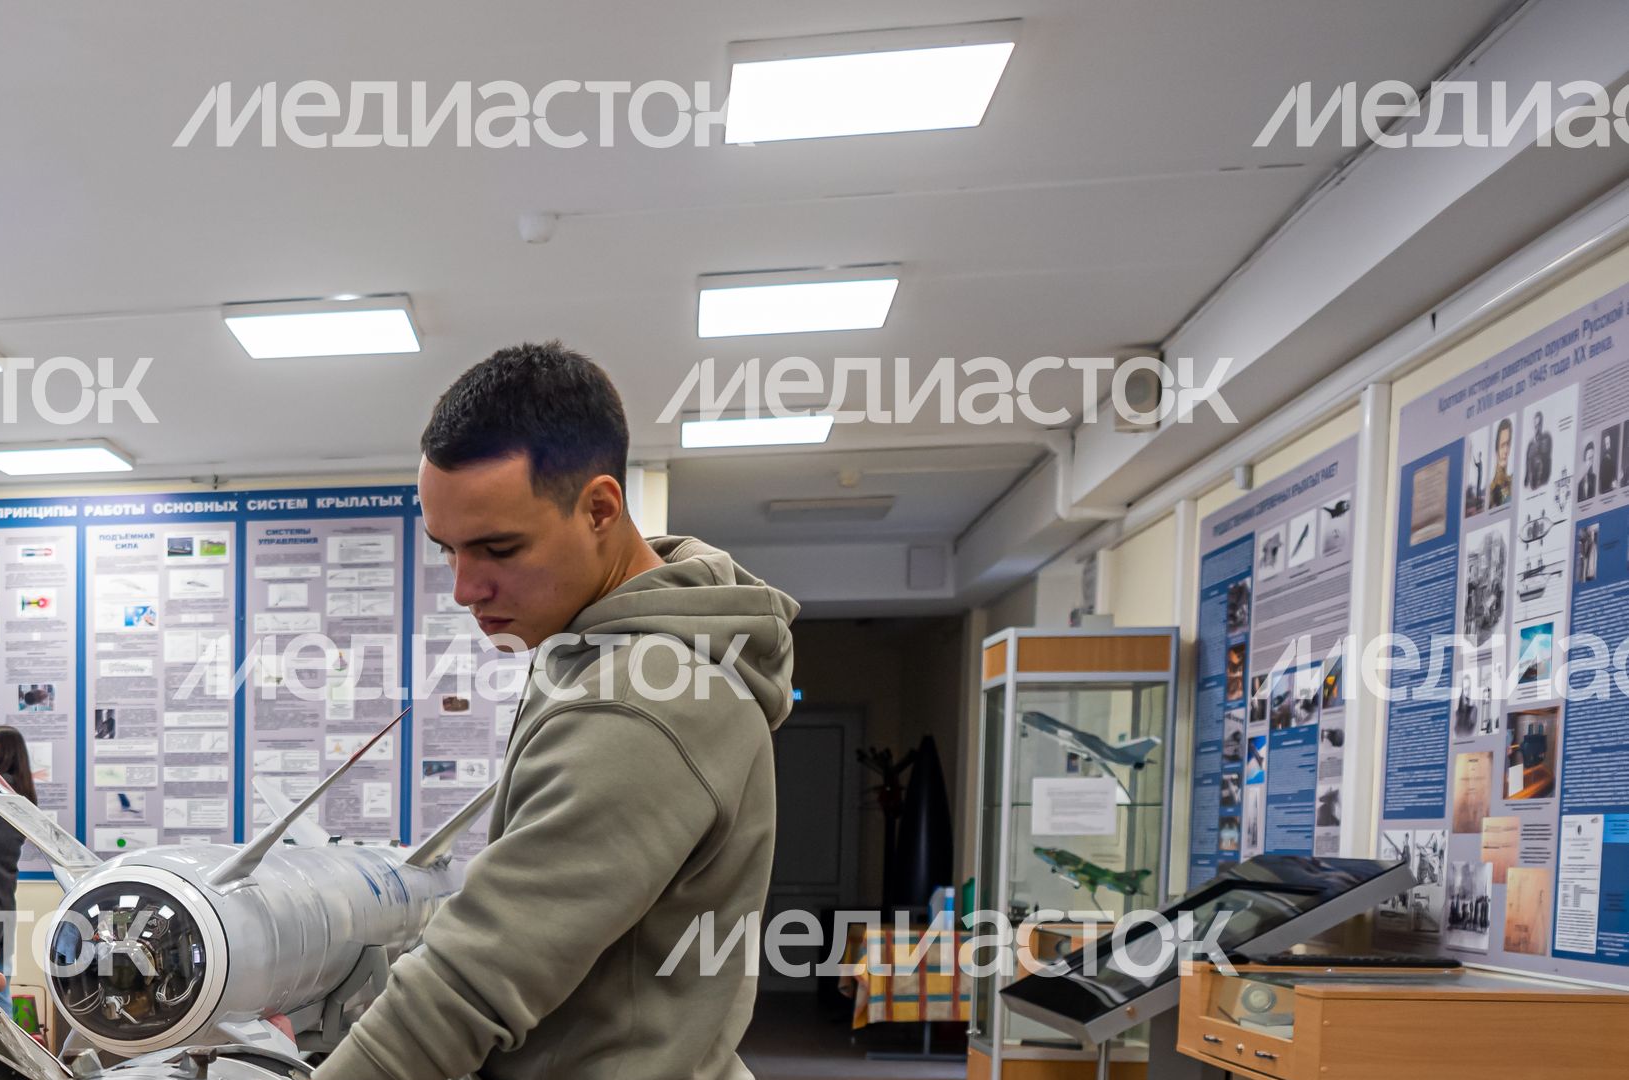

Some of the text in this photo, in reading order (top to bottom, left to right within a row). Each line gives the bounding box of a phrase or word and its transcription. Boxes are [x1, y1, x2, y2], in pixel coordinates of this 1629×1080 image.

[84, 503, 145, 517] РАБОТЫ
[152, 501, 238, 515] ОСНОВНЫХ
[247, 498, 308, 511] СИСТЕМ
[316, 495, 403, 509] КРЫЛАТЫХ
[265, 528, 311, 536] СИСТЕМЫ
[258, 537, 318, 545] УПРАВЛЕНИЯ
